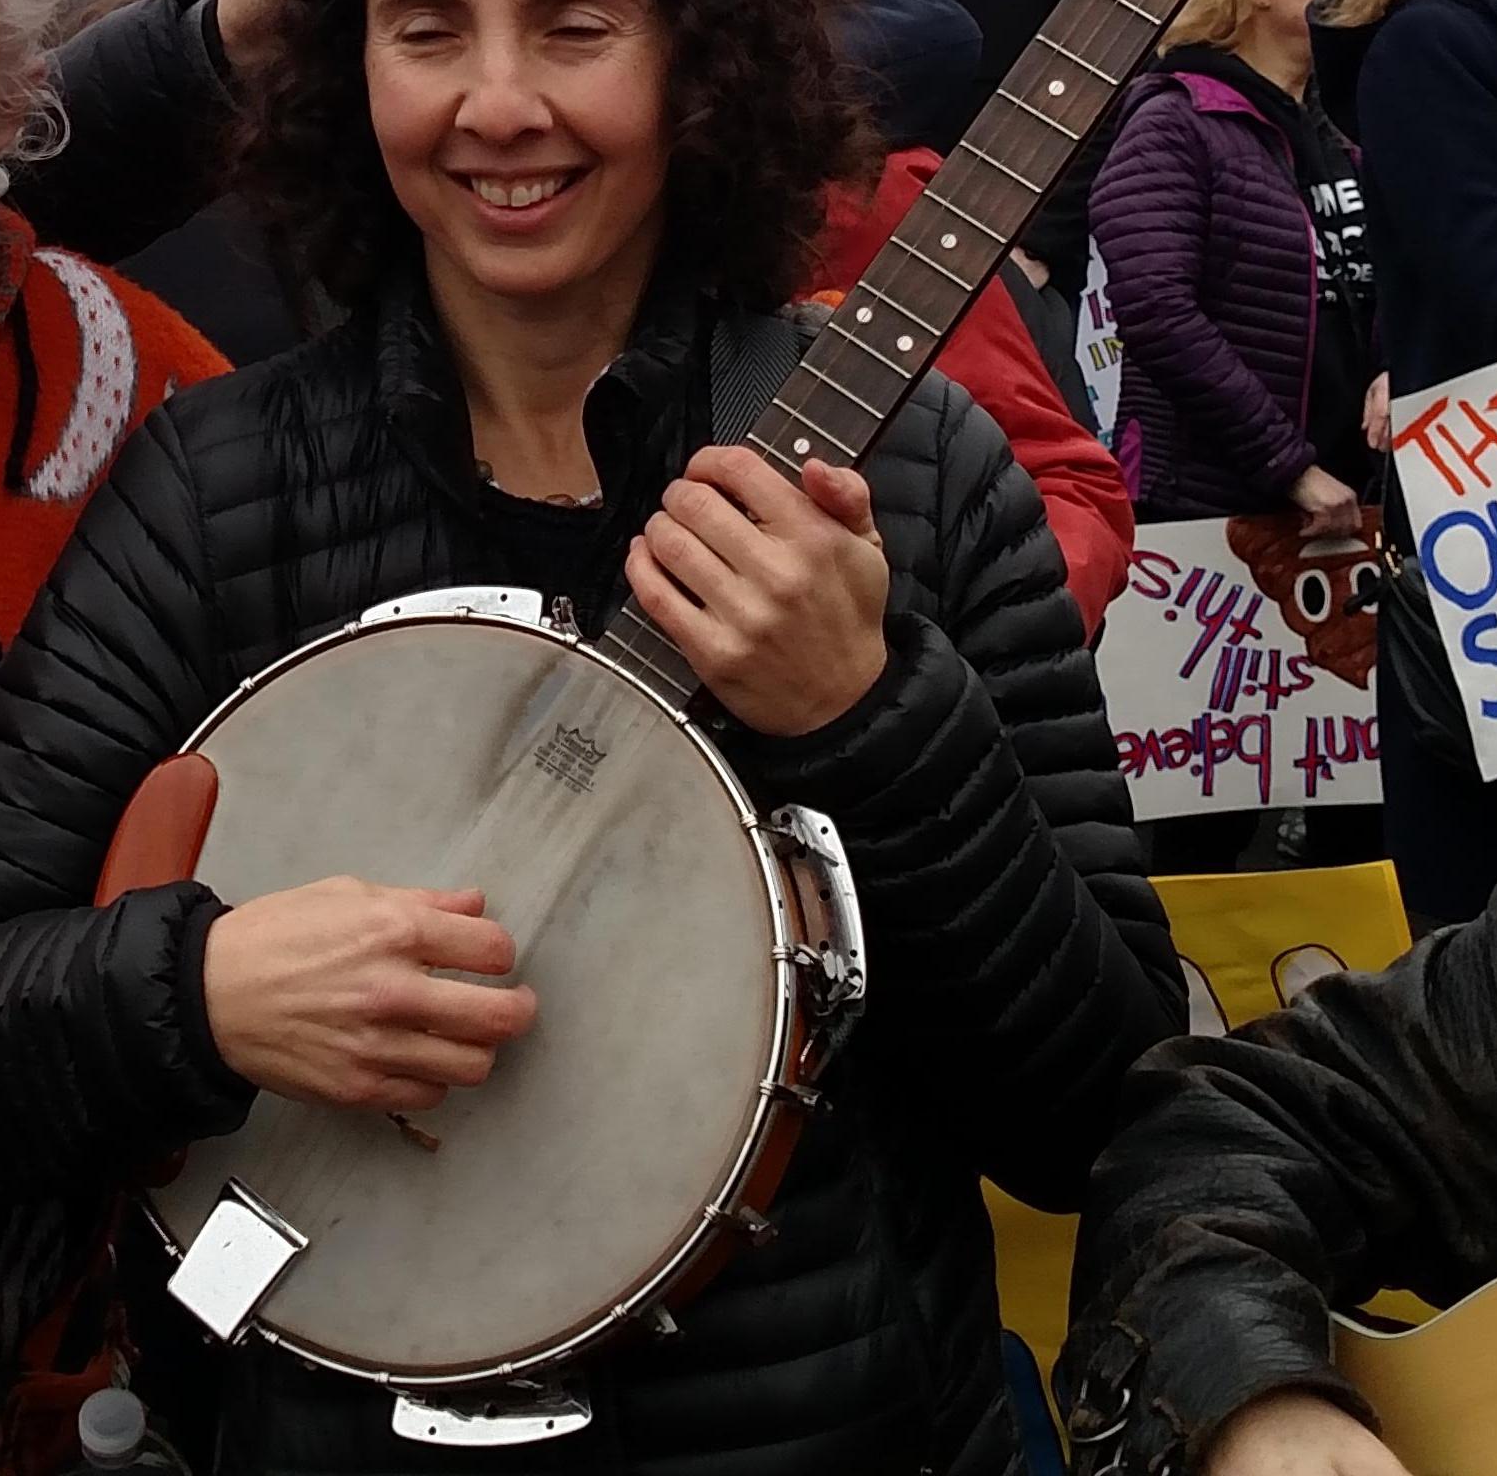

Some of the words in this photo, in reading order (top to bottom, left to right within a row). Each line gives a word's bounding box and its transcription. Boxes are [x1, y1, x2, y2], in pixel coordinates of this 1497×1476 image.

[1128, 550, 1263, 680] this
[1207, 646, 1314, 713] still
[1113, 713, 1271, 806] believe
